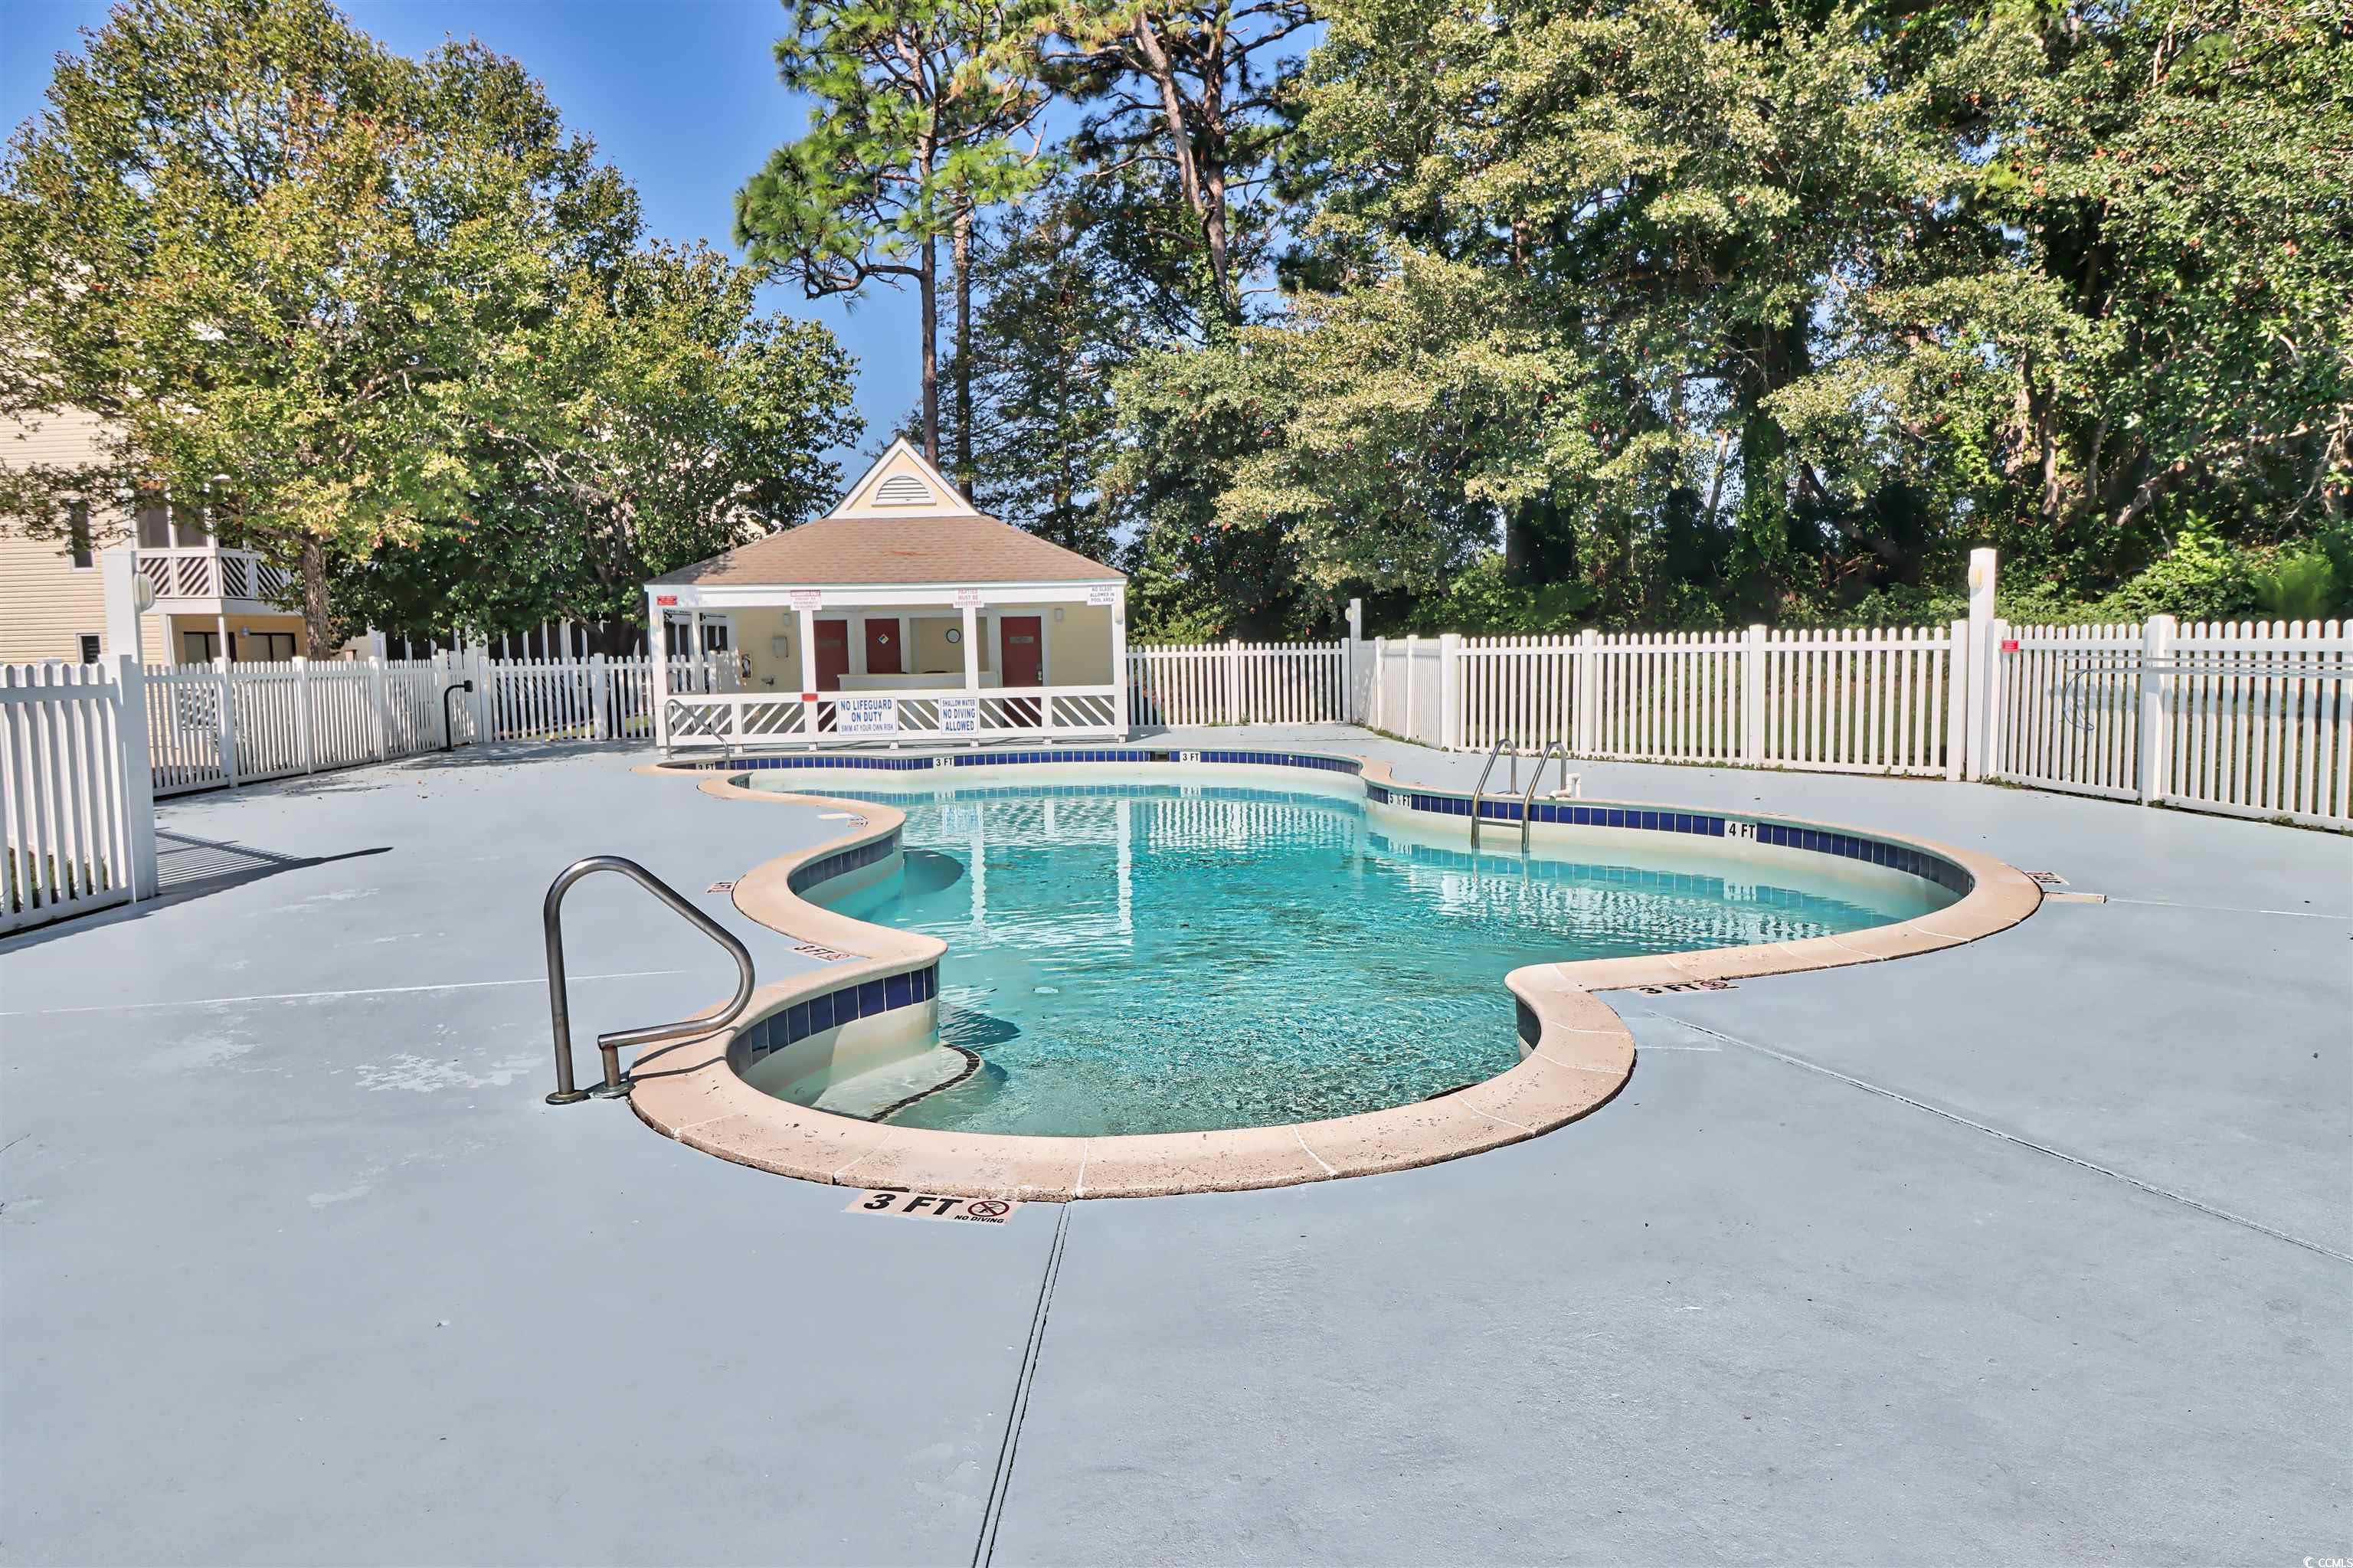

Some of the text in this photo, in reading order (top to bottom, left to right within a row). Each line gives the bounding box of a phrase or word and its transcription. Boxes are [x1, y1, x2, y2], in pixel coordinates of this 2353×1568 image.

[841, 699, 892, 711] NO LIFEGUARD
[851, 711, 882, 722] ON DUTY
[943, 708, 976, 719] NO DIVING
[945, 720, 974, 731] ALLOWED
[936, 758, 952, 767] 3 FT
[1190, 753, 1199, 761] FT
[1389, 793, 1394, 804] 5
[1402, 794, 1411, 807] FT
[1729, 823, 1756, 839] 4 FT
[1662, 983, 1700, 992] FT
[863, 1193, 964, 1216] 3 FT
[970, 1216, 1006, 1224] DIVING
